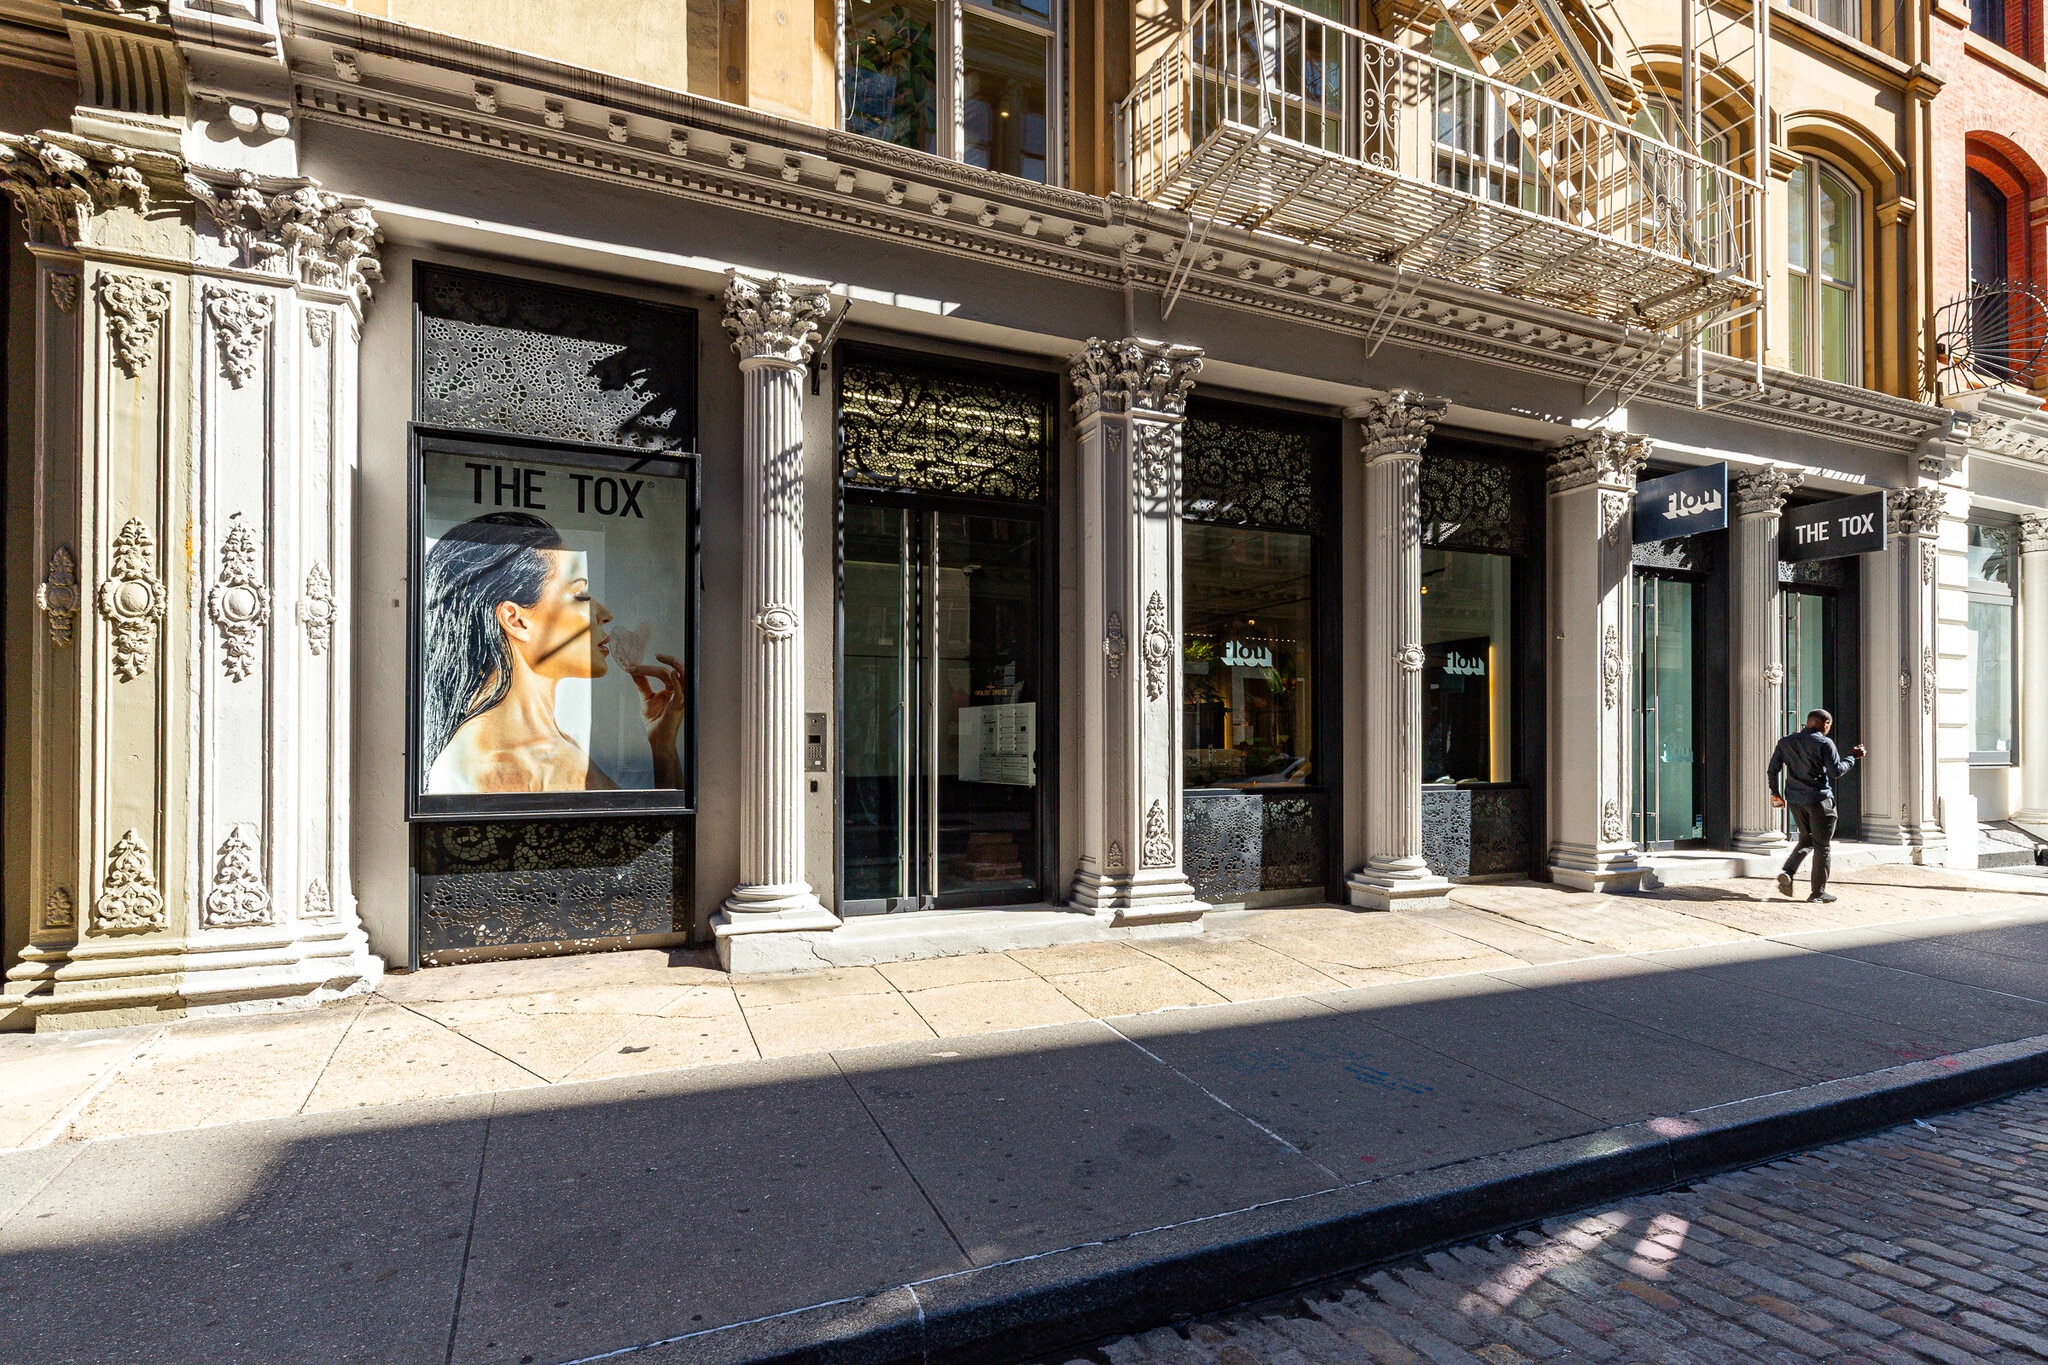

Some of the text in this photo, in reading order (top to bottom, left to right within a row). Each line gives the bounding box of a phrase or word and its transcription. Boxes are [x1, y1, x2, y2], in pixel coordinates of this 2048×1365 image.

[465, 462, 546, 510] THE
[1662, 488, 1722, 520] flou
[1795, 512, 1875, 545] THE TOX
[1220, 640, 1273, 667] flou
[1443, 651, 1485, 676] flou
